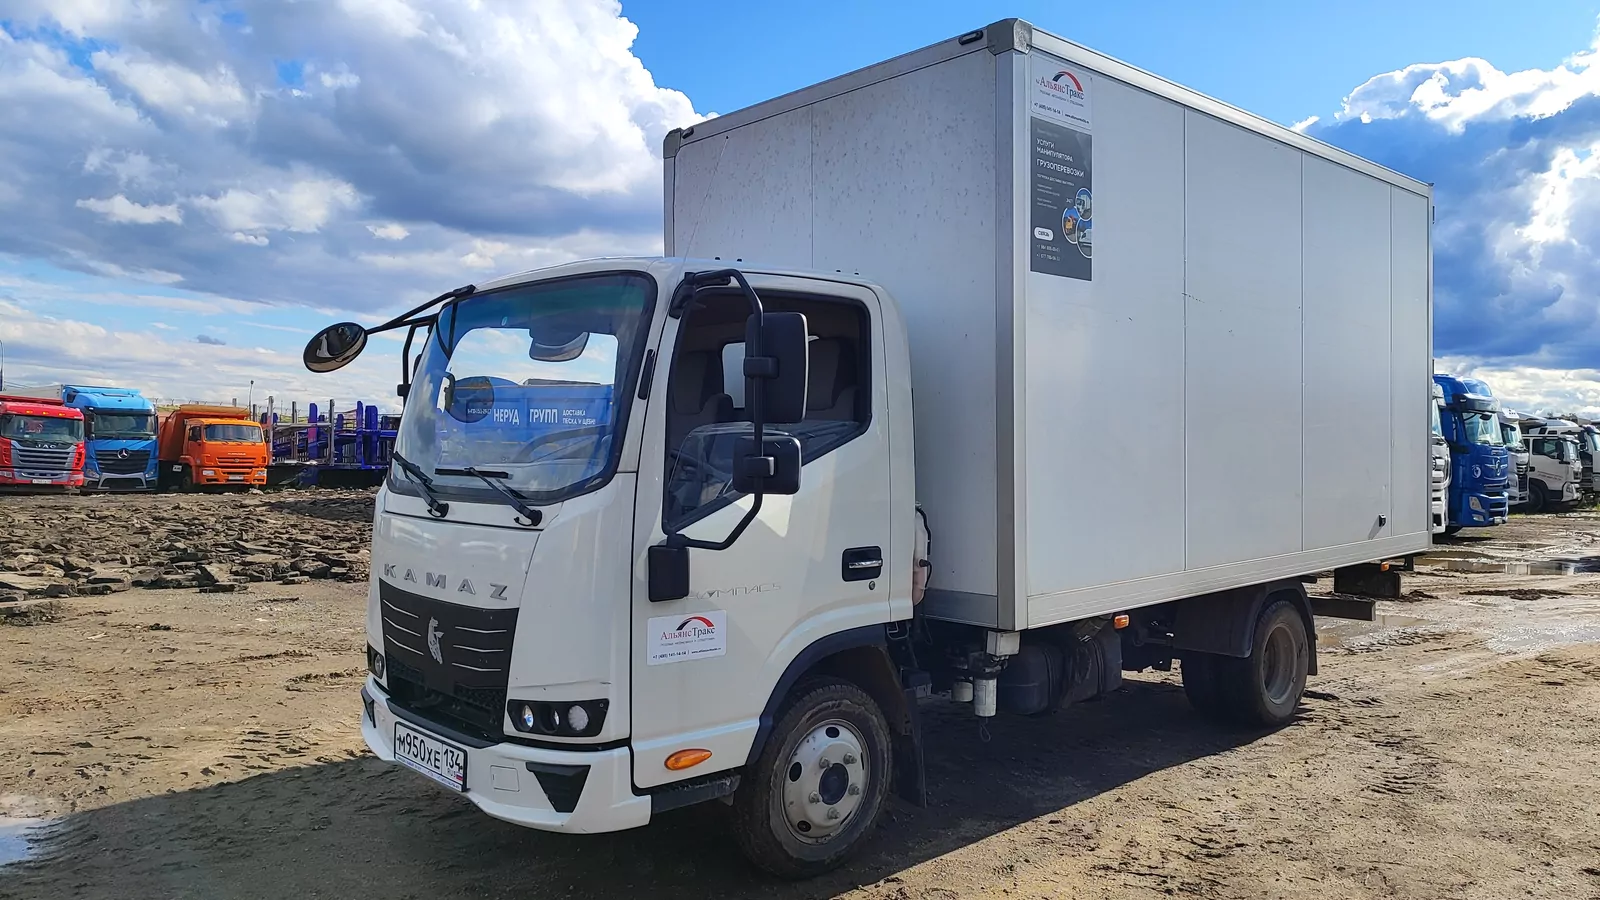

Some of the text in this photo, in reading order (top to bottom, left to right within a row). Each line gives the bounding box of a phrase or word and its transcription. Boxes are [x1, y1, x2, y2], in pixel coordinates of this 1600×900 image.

[1040, 76, 1085, 100] АльянсТракс
[1036, 138, 1055, 149] УСЛУГИ
[1036, 147, 1074, 162] МАНИПУЛЯТОРА
[1036, 159, 1085, 178] ГРУЗОПЕРЕВОЗКИ
[493, 408, 520, 425] НЕРУД
[529, 408, 558, 424] ГРУПП
[562, 409, 586, 417] ДОСТАВКА
[562, 417, 577, 425] ПЕСКА
[384, 563, 509, 601] KAMAZ
[660, 627, 716, 641] АльянсТракс
[443, 748, 461, 772] 134
